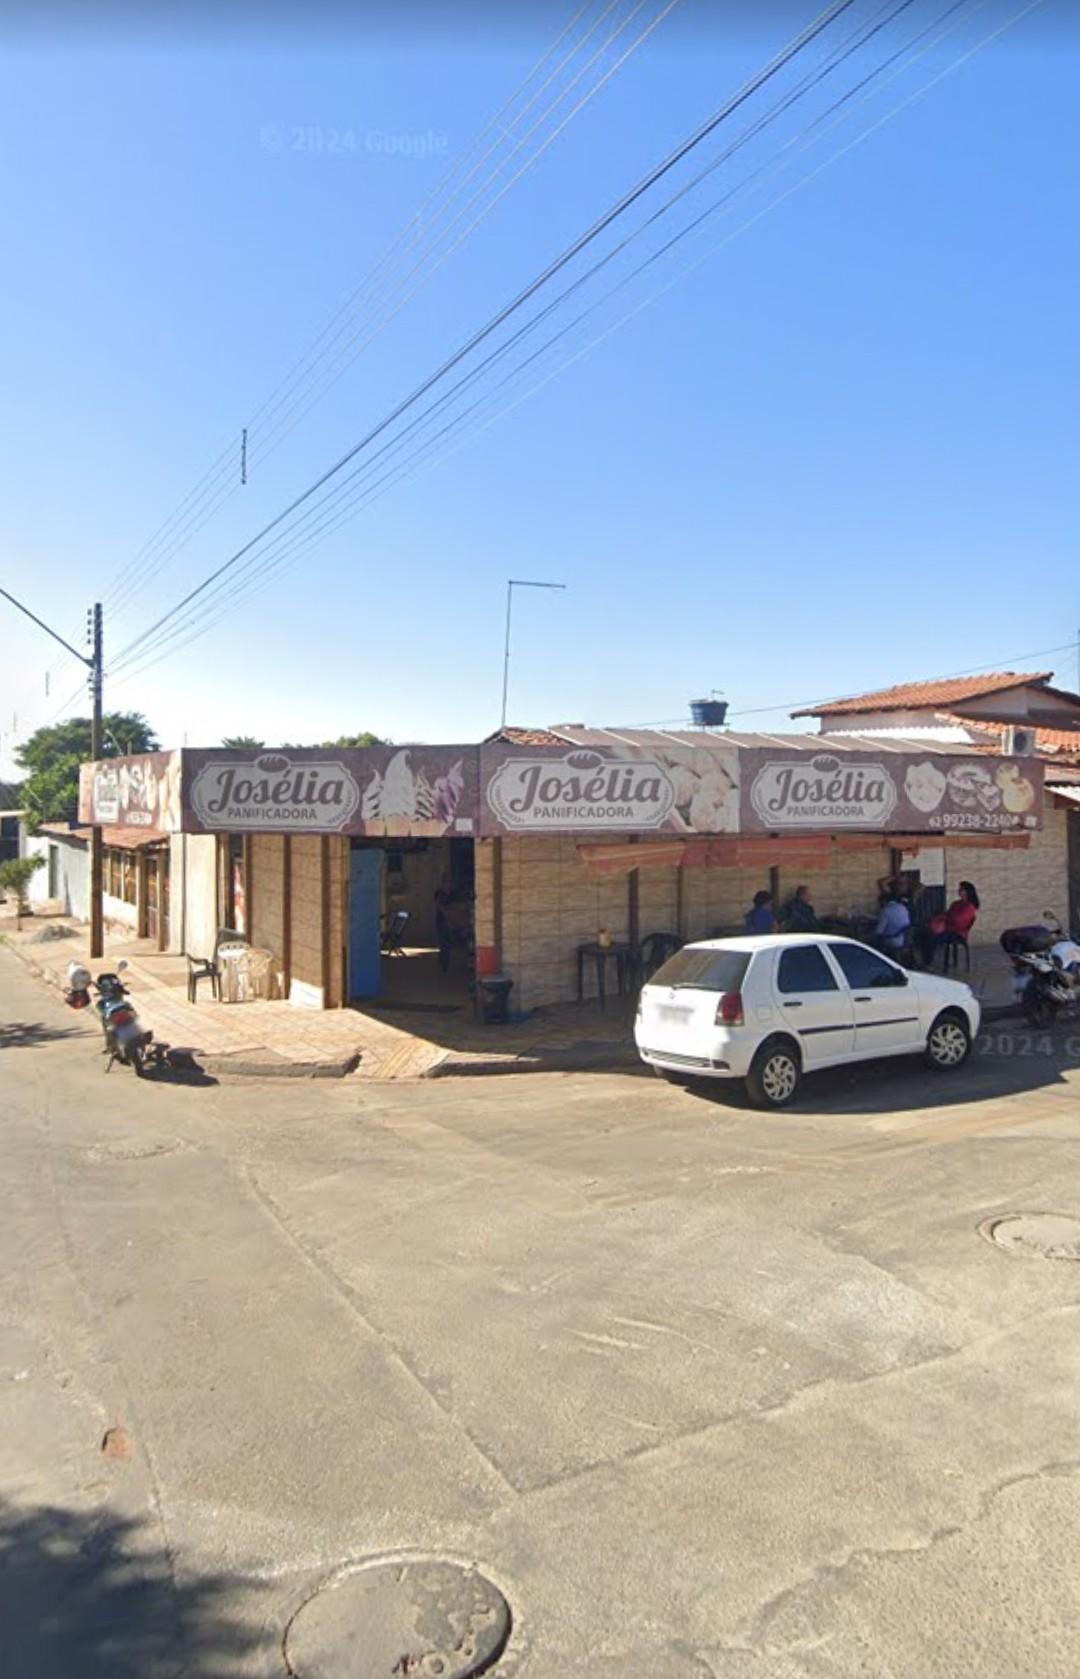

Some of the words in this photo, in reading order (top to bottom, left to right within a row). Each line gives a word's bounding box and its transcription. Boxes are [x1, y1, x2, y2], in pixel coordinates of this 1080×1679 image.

[207, 769, 344, 813] Josélia
[509, 765, 661, 813] Josélia
[768, 768, 885, 812] Josélia
[227, 807, 318, 820] PANIFICADORA
[533, 806, 634, 818] PANIFICADORA
[787, 805, 864, 817] PANIFICADORA
